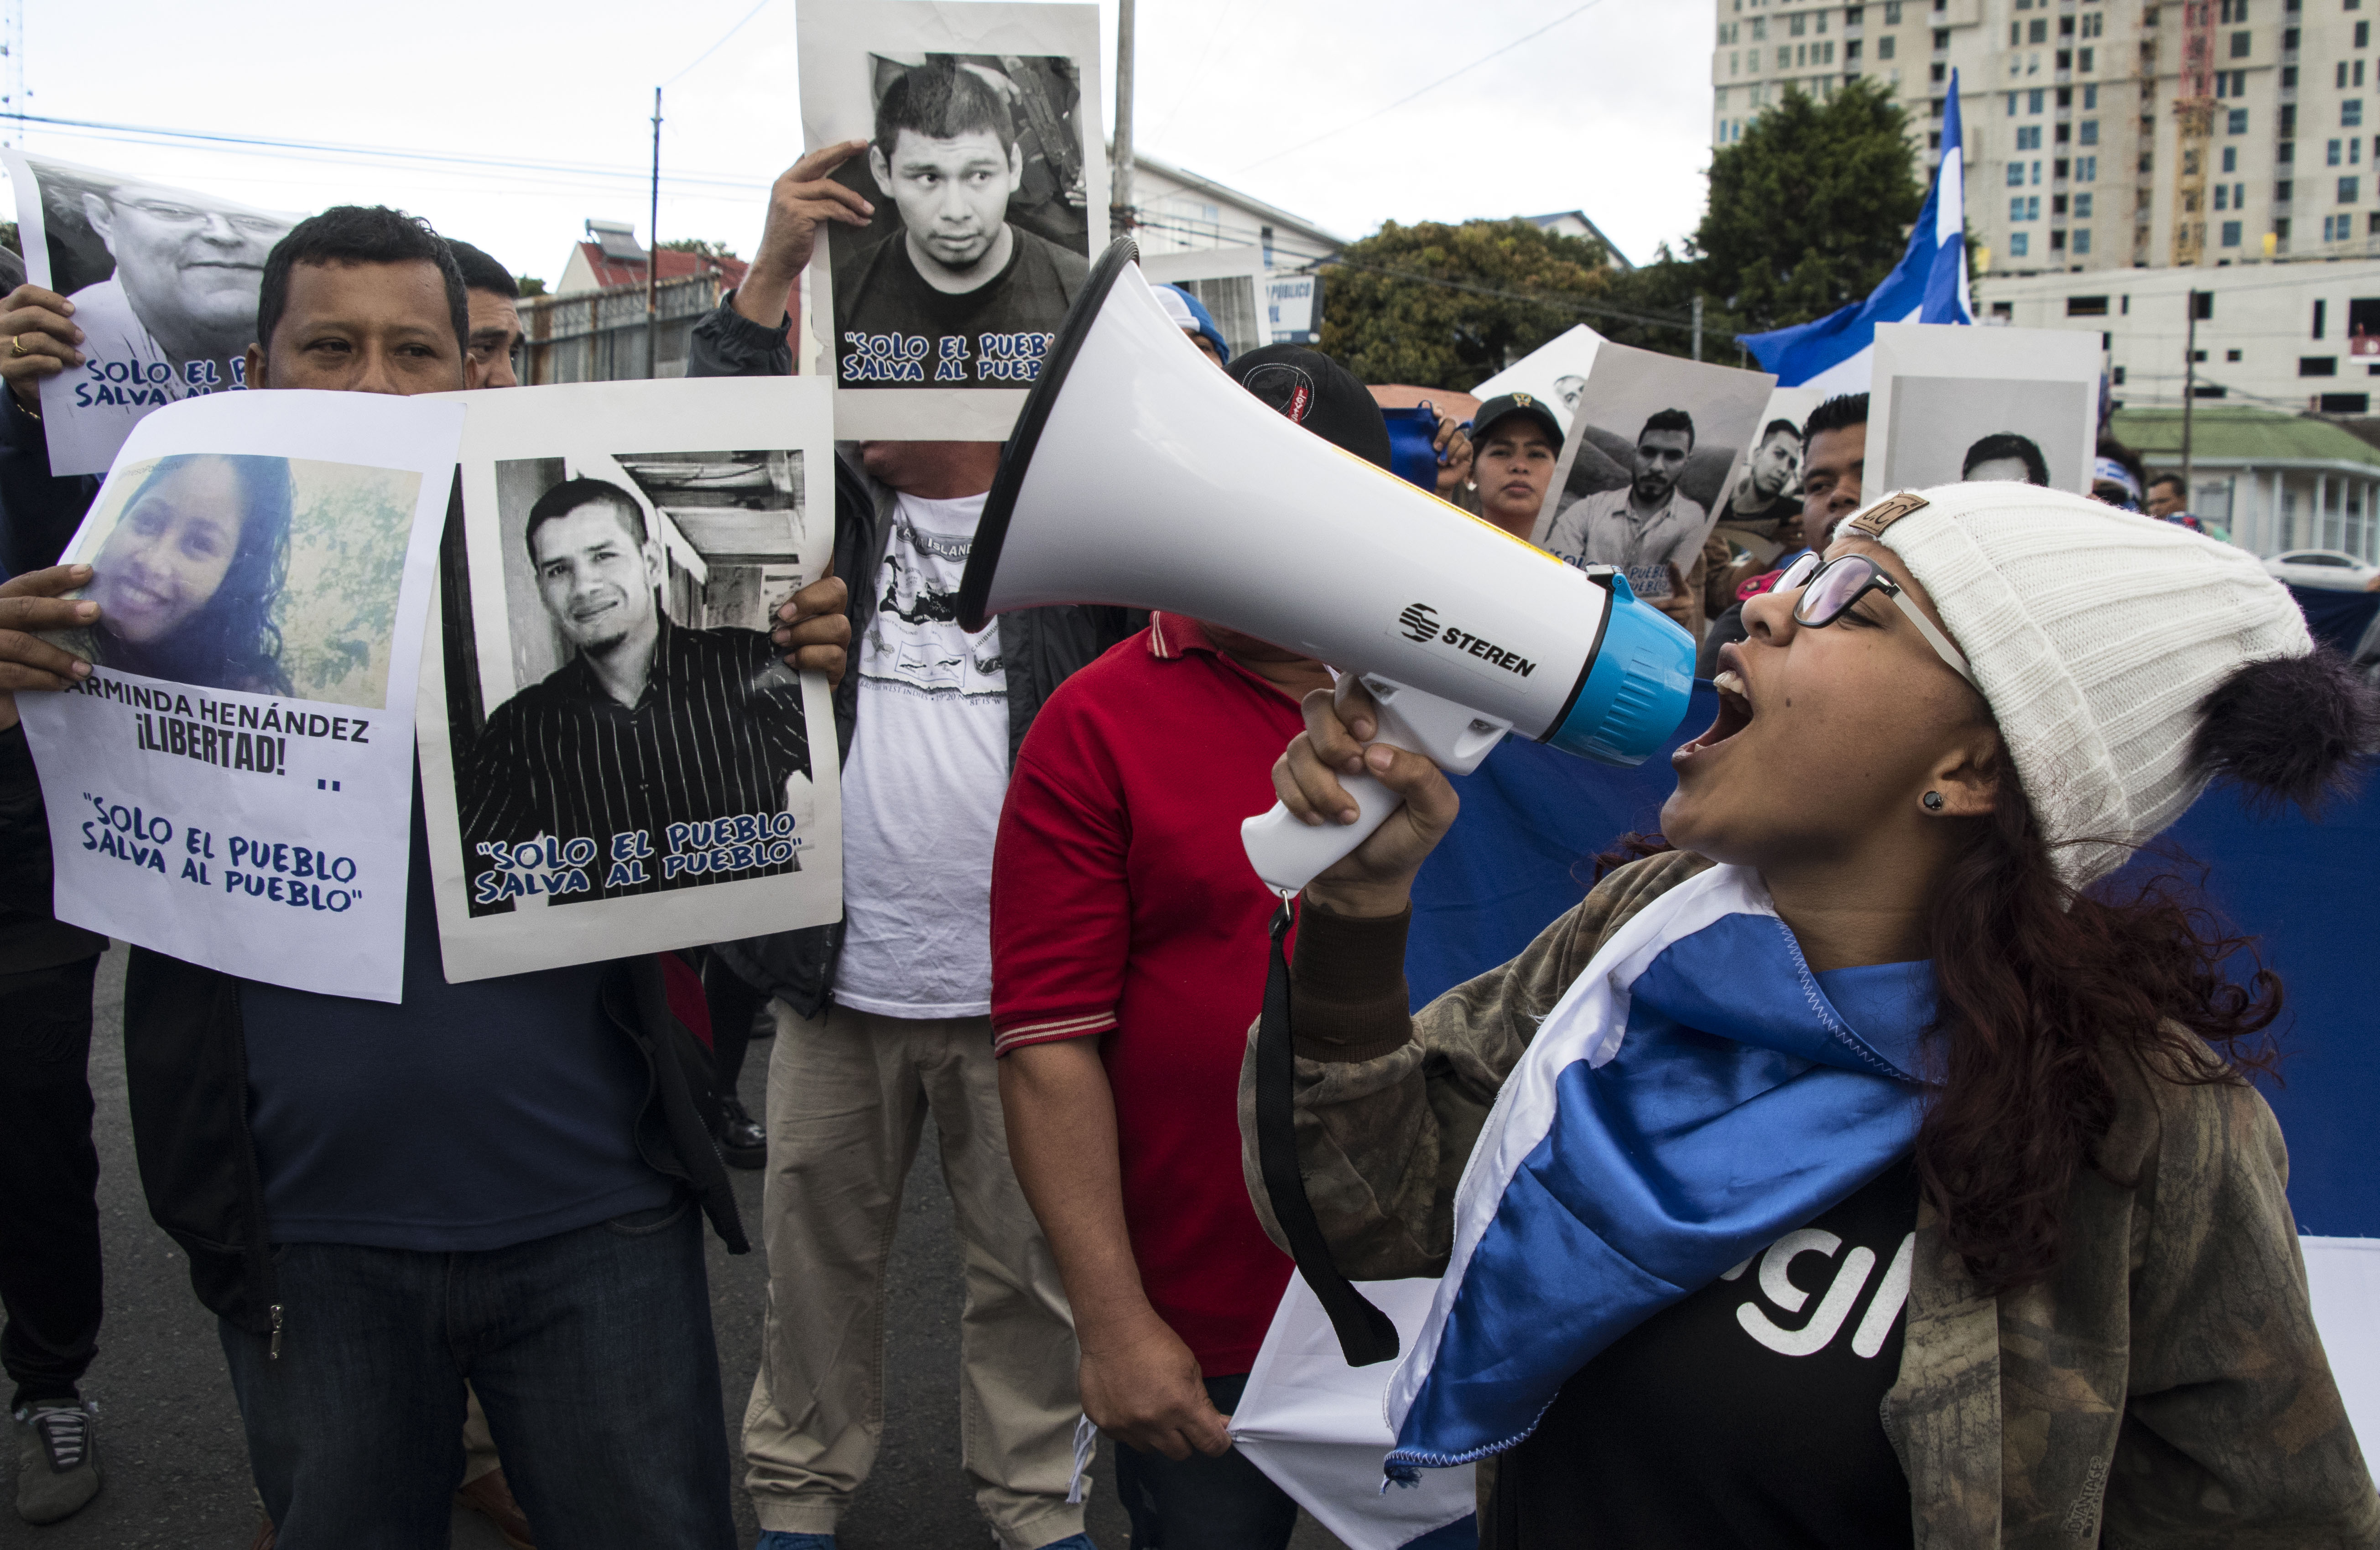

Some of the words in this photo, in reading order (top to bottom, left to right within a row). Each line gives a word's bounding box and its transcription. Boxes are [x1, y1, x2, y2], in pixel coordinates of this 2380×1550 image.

[86, 359, 172, 385] SOLO
[185, 359, 221, 385] EL
[843, 354, 924, 381] SALVA
[935, 359, 968, 381] AL
[845, 332, 929, 359] "SOLO
[938, 335, 971, 359] EL
[979, 332, 1054, 359] PUEB
[75, 382, 167, 408] SALVA
[1442, 627, 1537, 678] STEREN
[64, 676, 194, 718] ARMINDA
[199, 698, 369, 744] HENÁNDEZ
[882, 684, 901, 693] WEST
[135, 713, 286, 776] ¡LIBERTAD!
[83, 792, 172, 844] "SOLO
[186, 827, 215, 859] EL
[229, 836, 356, 883] PUEBLO
[476, 835, 597, 870] "SOLO
[611, 830, 655, 861] EL
[666, 811, 796, 854] PUEBLO
[82, 821, 166, 874] SALVA
[181, 858, 212, 885] AL
[224, 870, 362, 913] PUEBLO"
[475, 868, 590, 904] SALVA
[605, 860, 651, 889] AL
[662, 837, 802, 879] PUEBLO"
